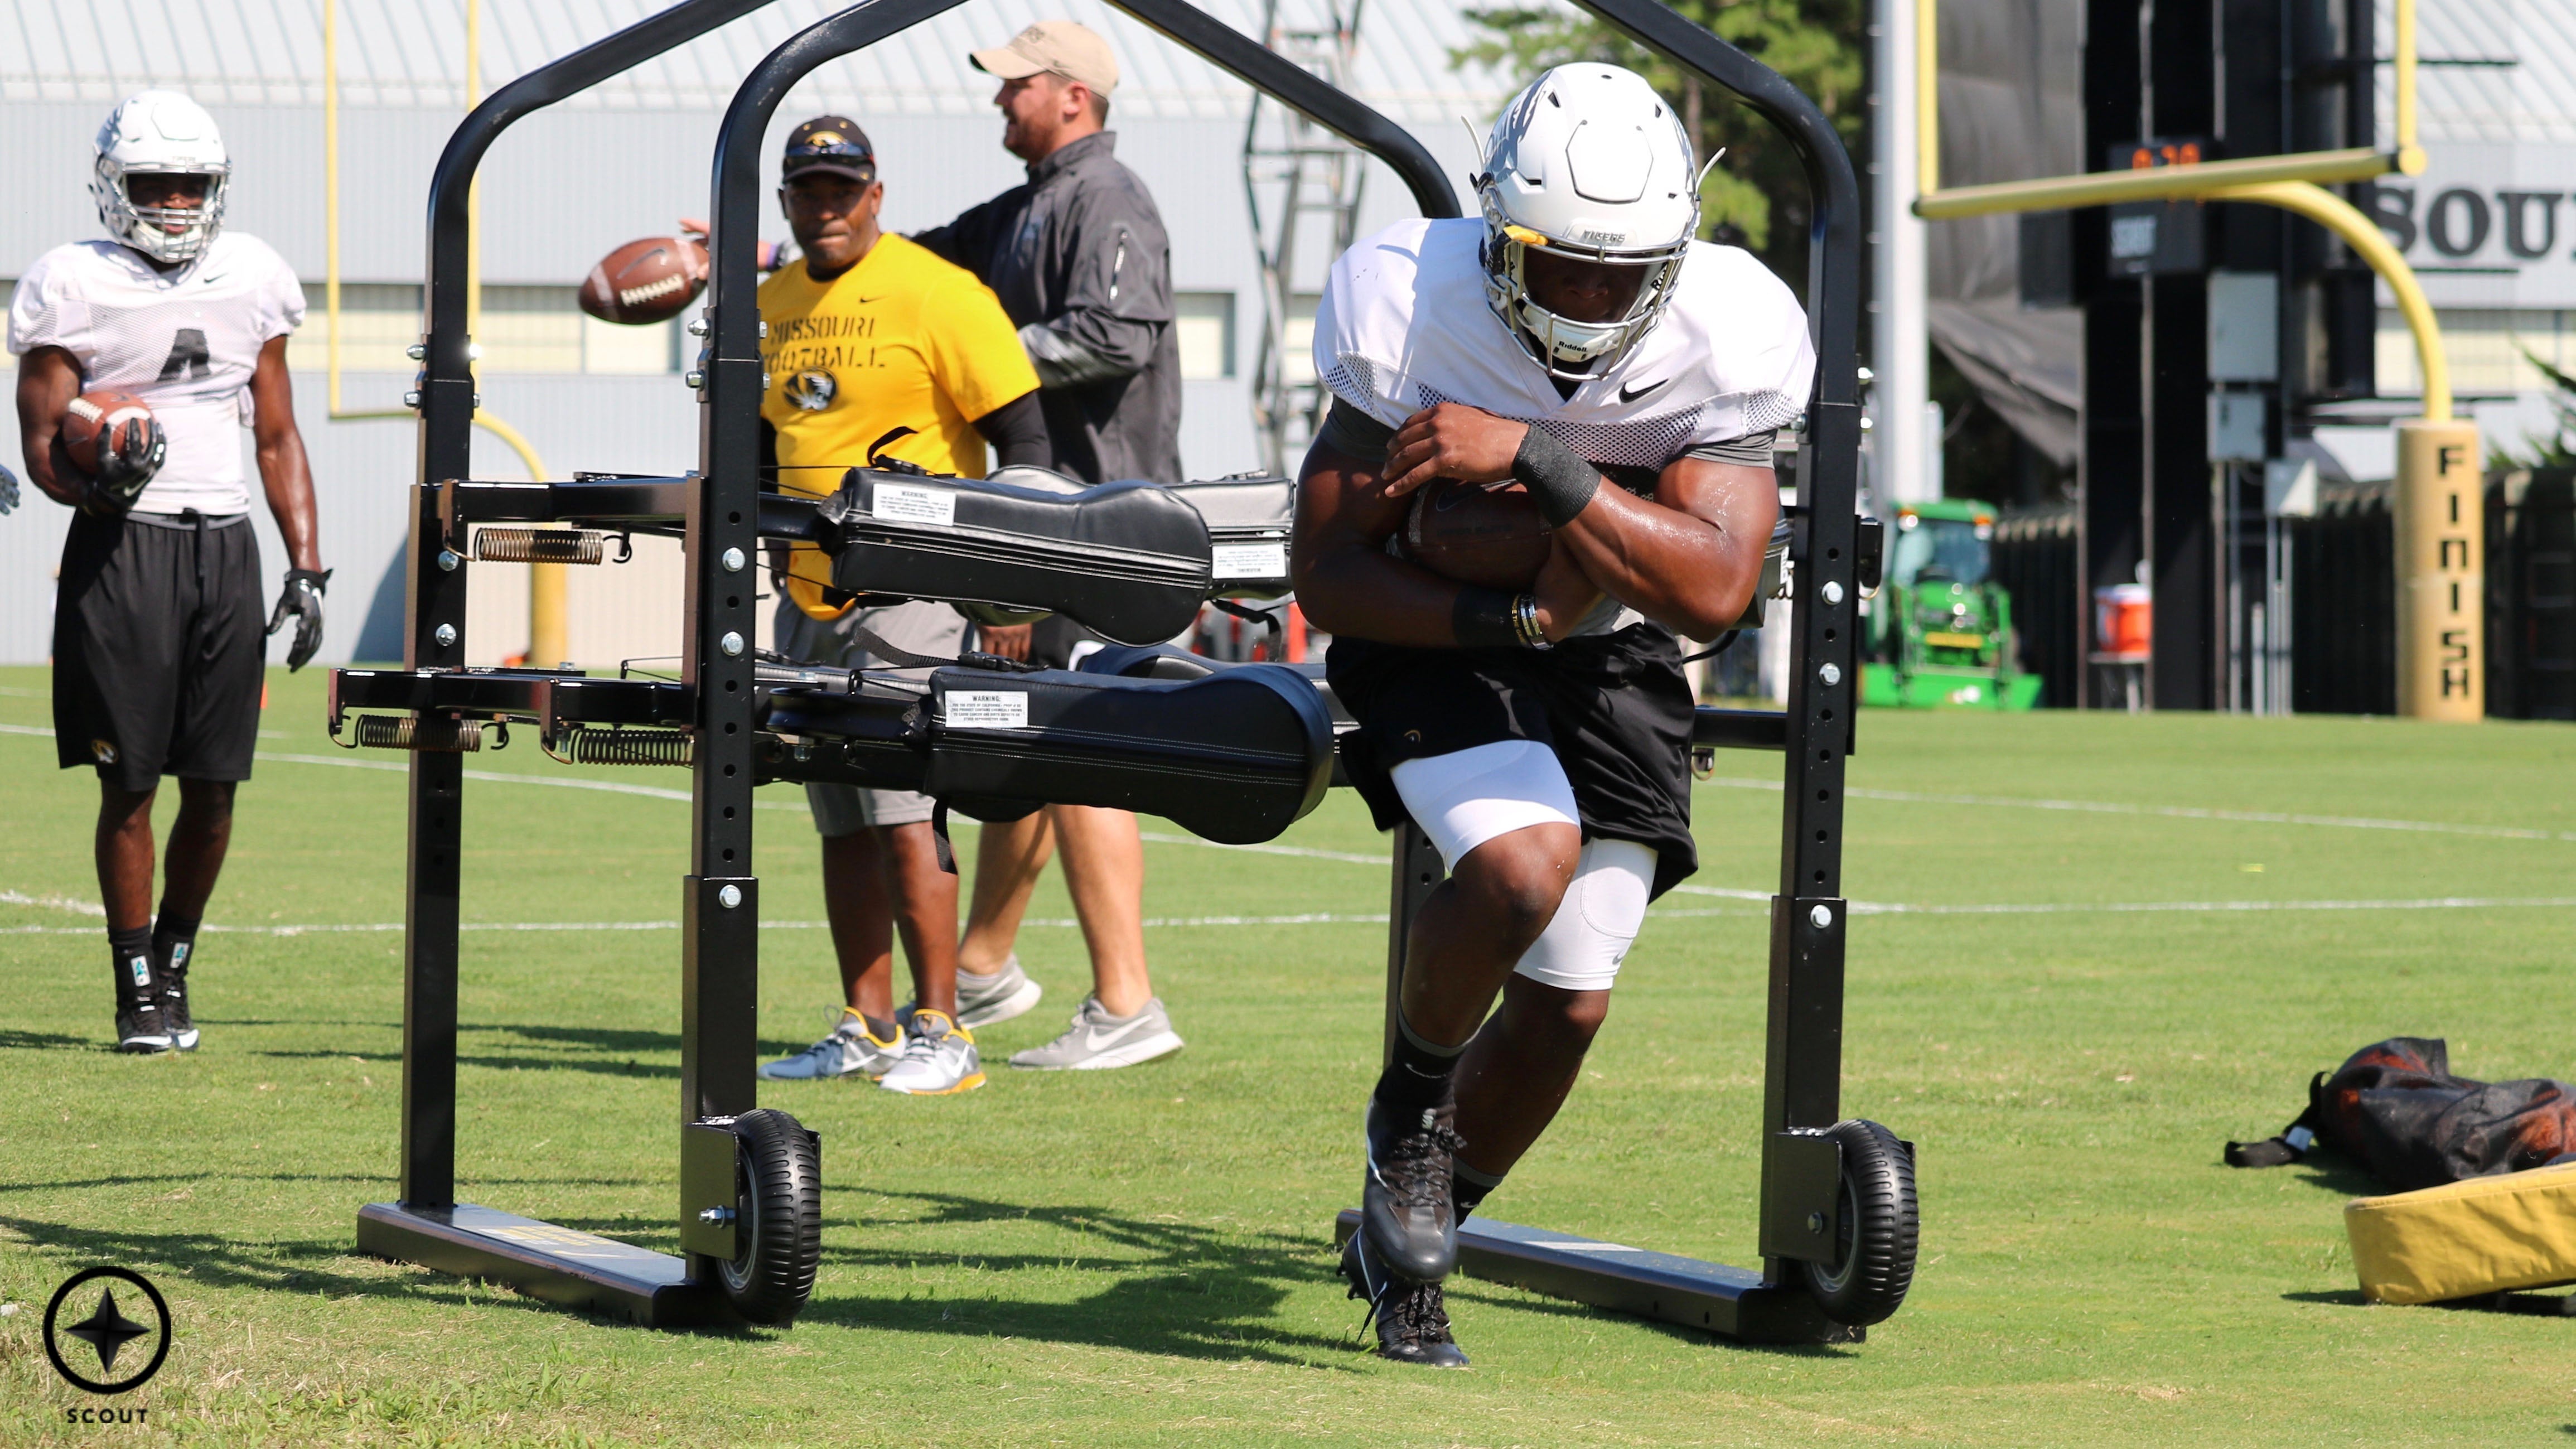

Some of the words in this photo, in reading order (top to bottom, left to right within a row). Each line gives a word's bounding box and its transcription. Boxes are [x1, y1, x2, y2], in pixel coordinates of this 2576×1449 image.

[2374, 188, 2576, 259] SOU
[770, 316, 874, 345] MISSOURI
[2438, 447, 2468, 697] FINISH
